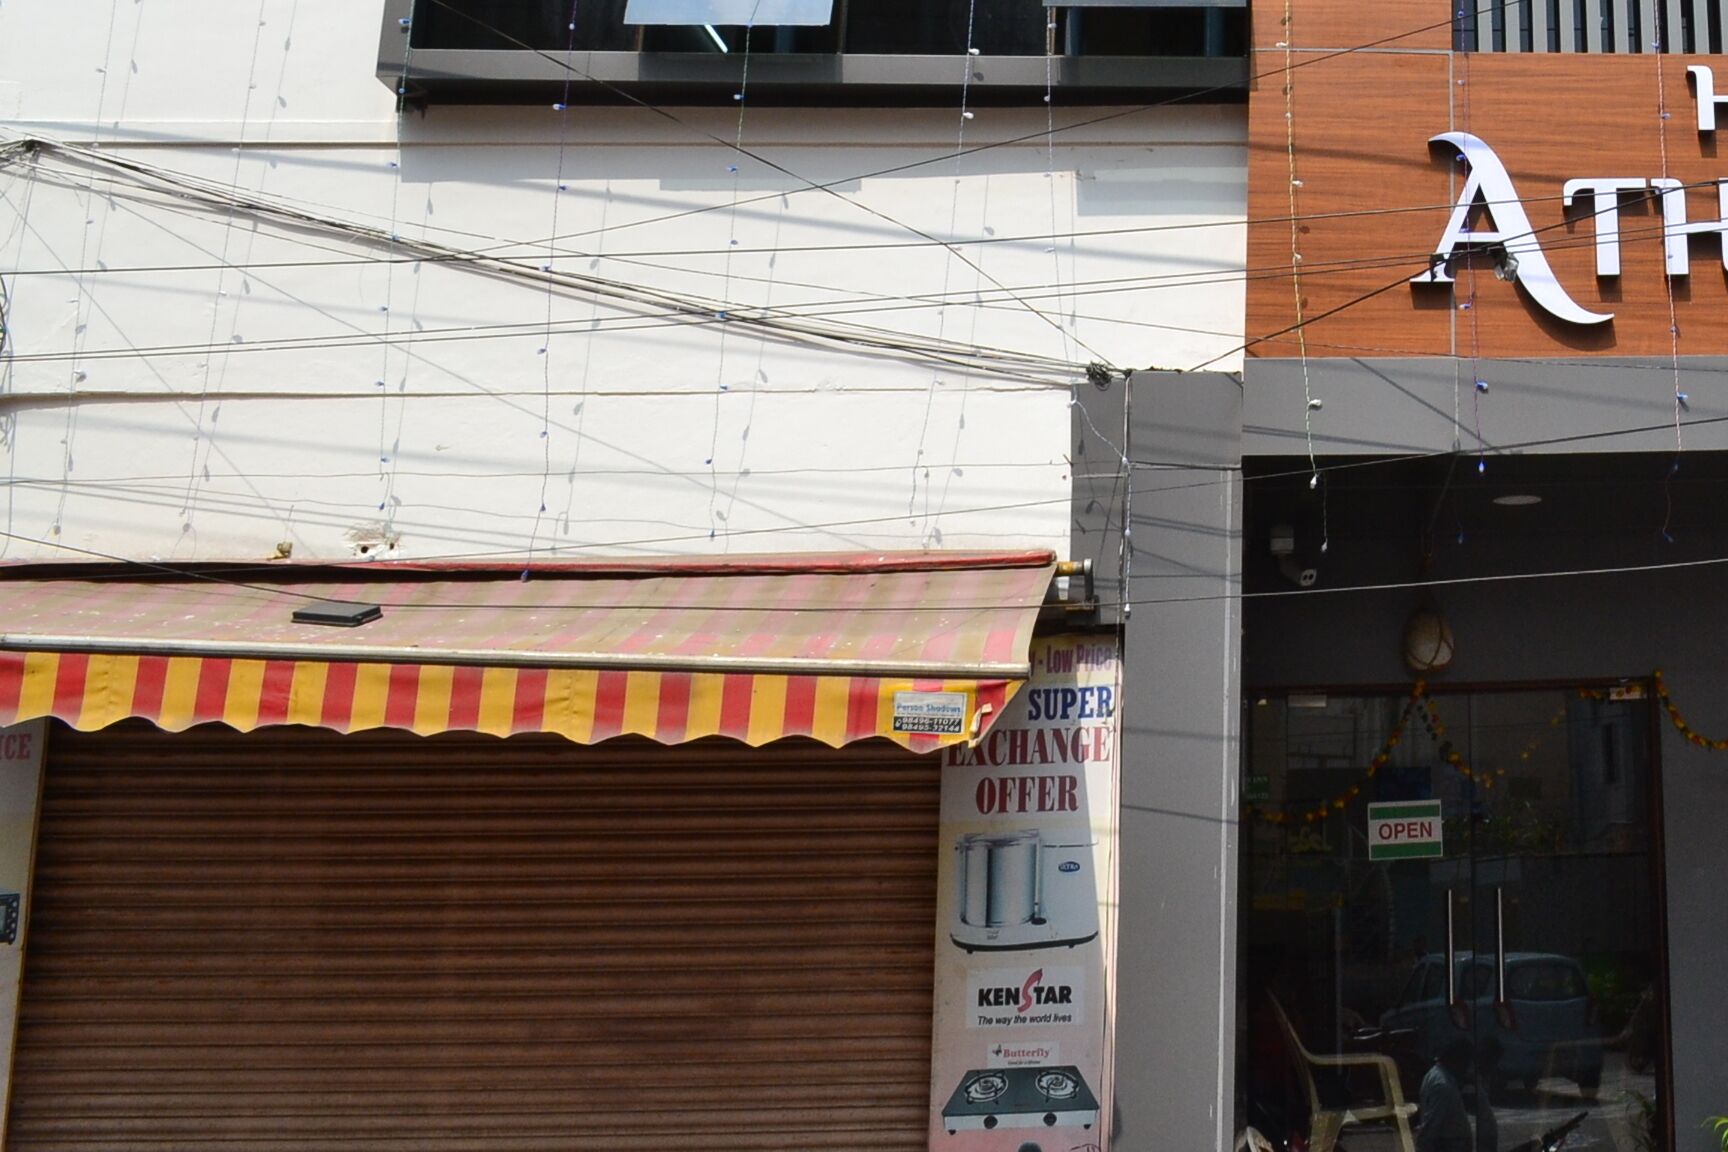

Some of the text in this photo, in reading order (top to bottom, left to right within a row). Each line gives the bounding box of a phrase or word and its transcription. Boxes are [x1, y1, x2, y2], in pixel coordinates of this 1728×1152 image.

[1046, 645, 1073, 674] Low
[1077, 643, 1112, 672] Price
[1028, 687, 1114, 721] SUPER
[947, 727, 1111, 767] EXCHANGE
[975, 775, 1079, 815] OFFER
[1378, 822, 1433, 840] OPEN
[978, 968, 1072, 1013] KENSTAR
[978, 1013, 1072, 1026] The way the world lives
[1003, 1048, 1049, 1058] Butterfly
